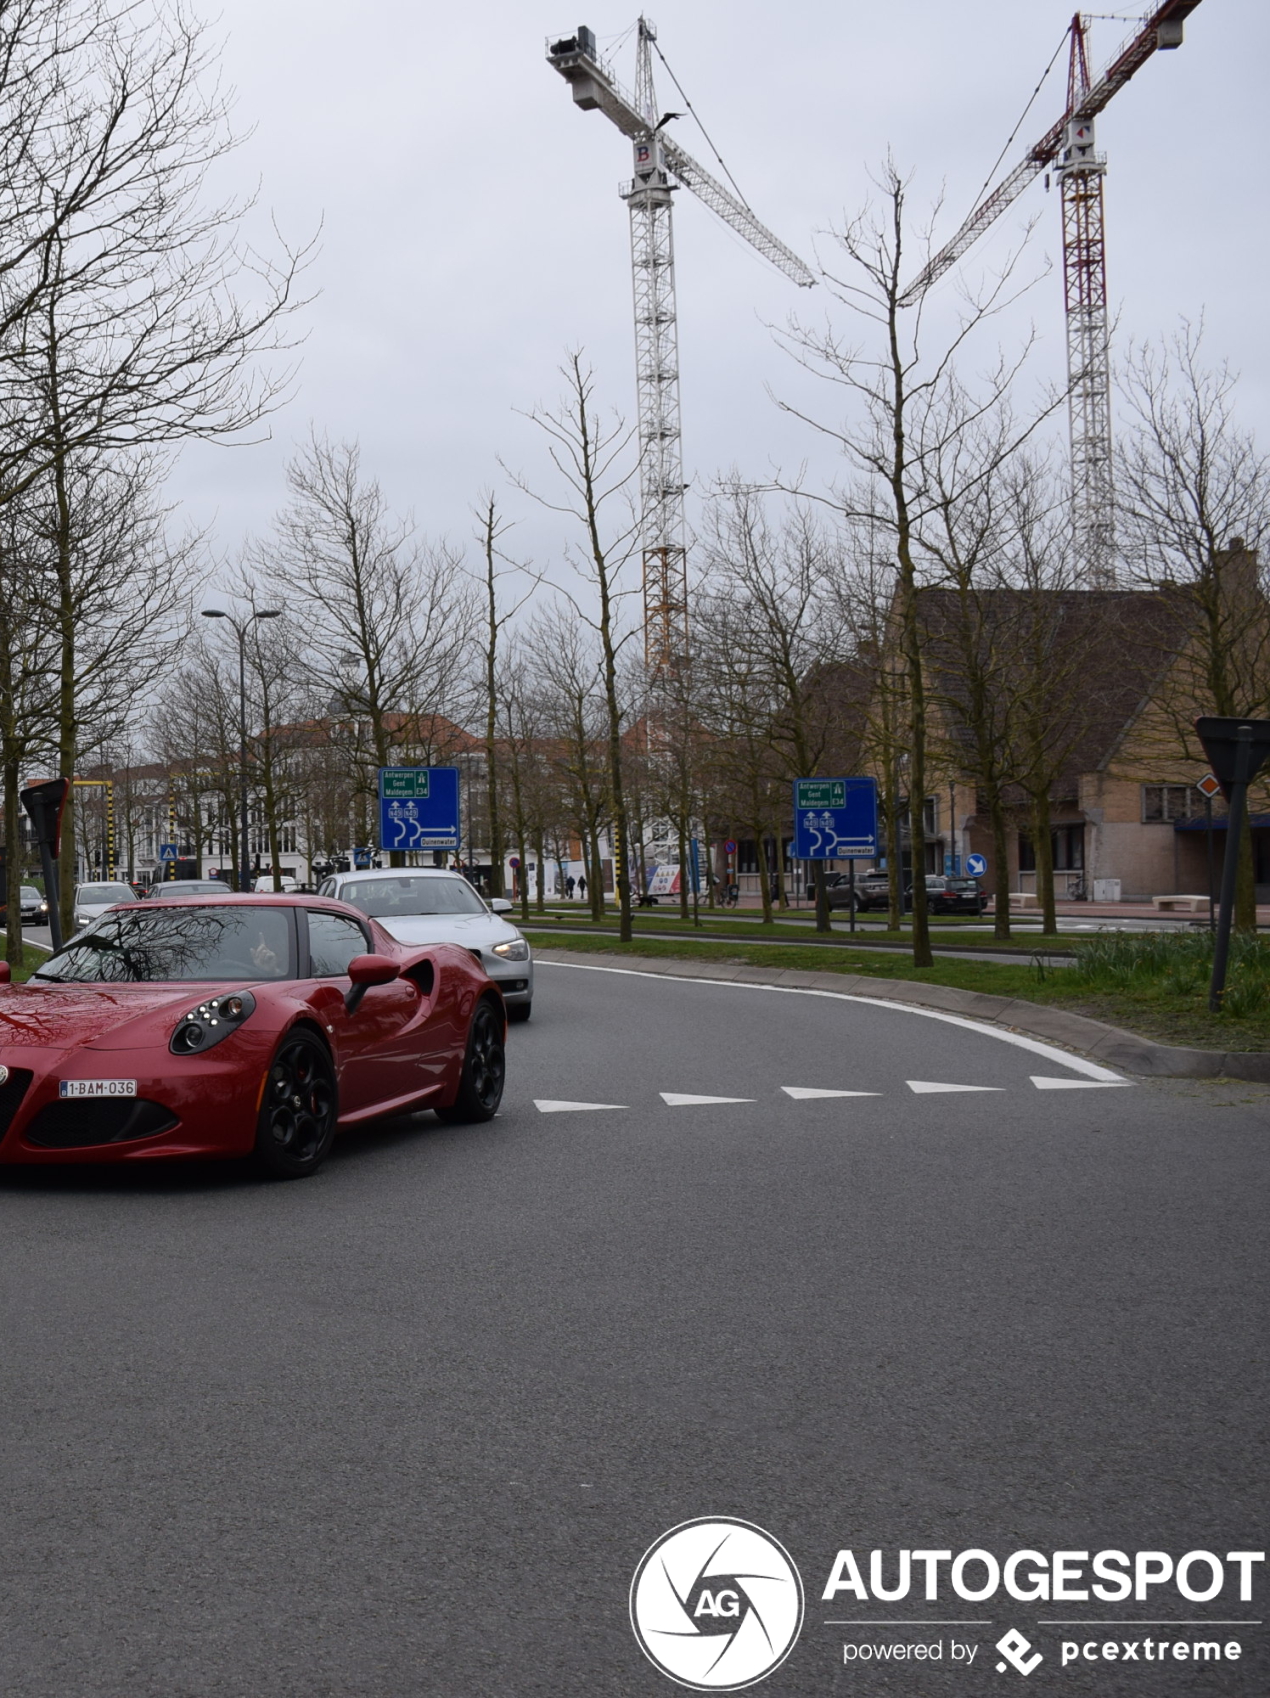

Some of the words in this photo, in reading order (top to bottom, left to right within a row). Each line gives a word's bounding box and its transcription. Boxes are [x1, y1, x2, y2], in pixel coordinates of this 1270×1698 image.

[637, 146, 649, 162] B
[384, 772, 414, 780] Antwerpen
[385, 789, 413, 797] Maldegem
[800, 799, 829, 807] Maldegem
[422, 838, 456, 846] Duinenwater
[838, 847, 874, 855] Duinenwater
[69, 1082, 134, 1095] 1-BAM-036
